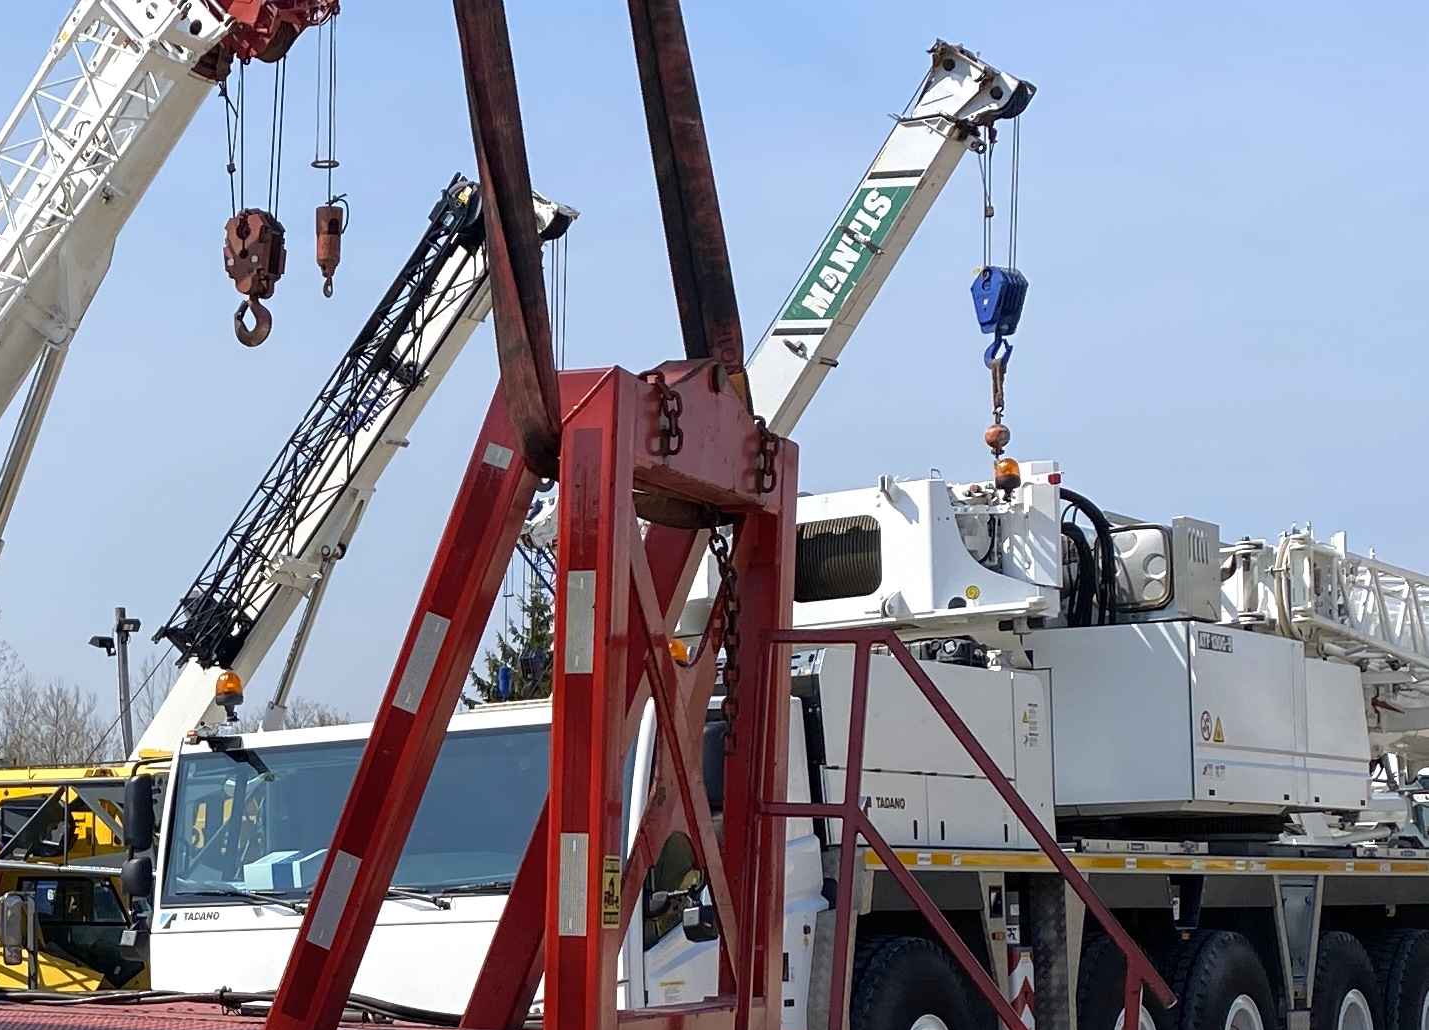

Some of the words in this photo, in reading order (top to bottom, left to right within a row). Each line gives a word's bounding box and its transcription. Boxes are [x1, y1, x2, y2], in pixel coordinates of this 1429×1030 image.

[801, 189, 892, 318] MANTIS
[876, 796, 906, 810] TADANO
[184, 911, 220, 921] TADANO
